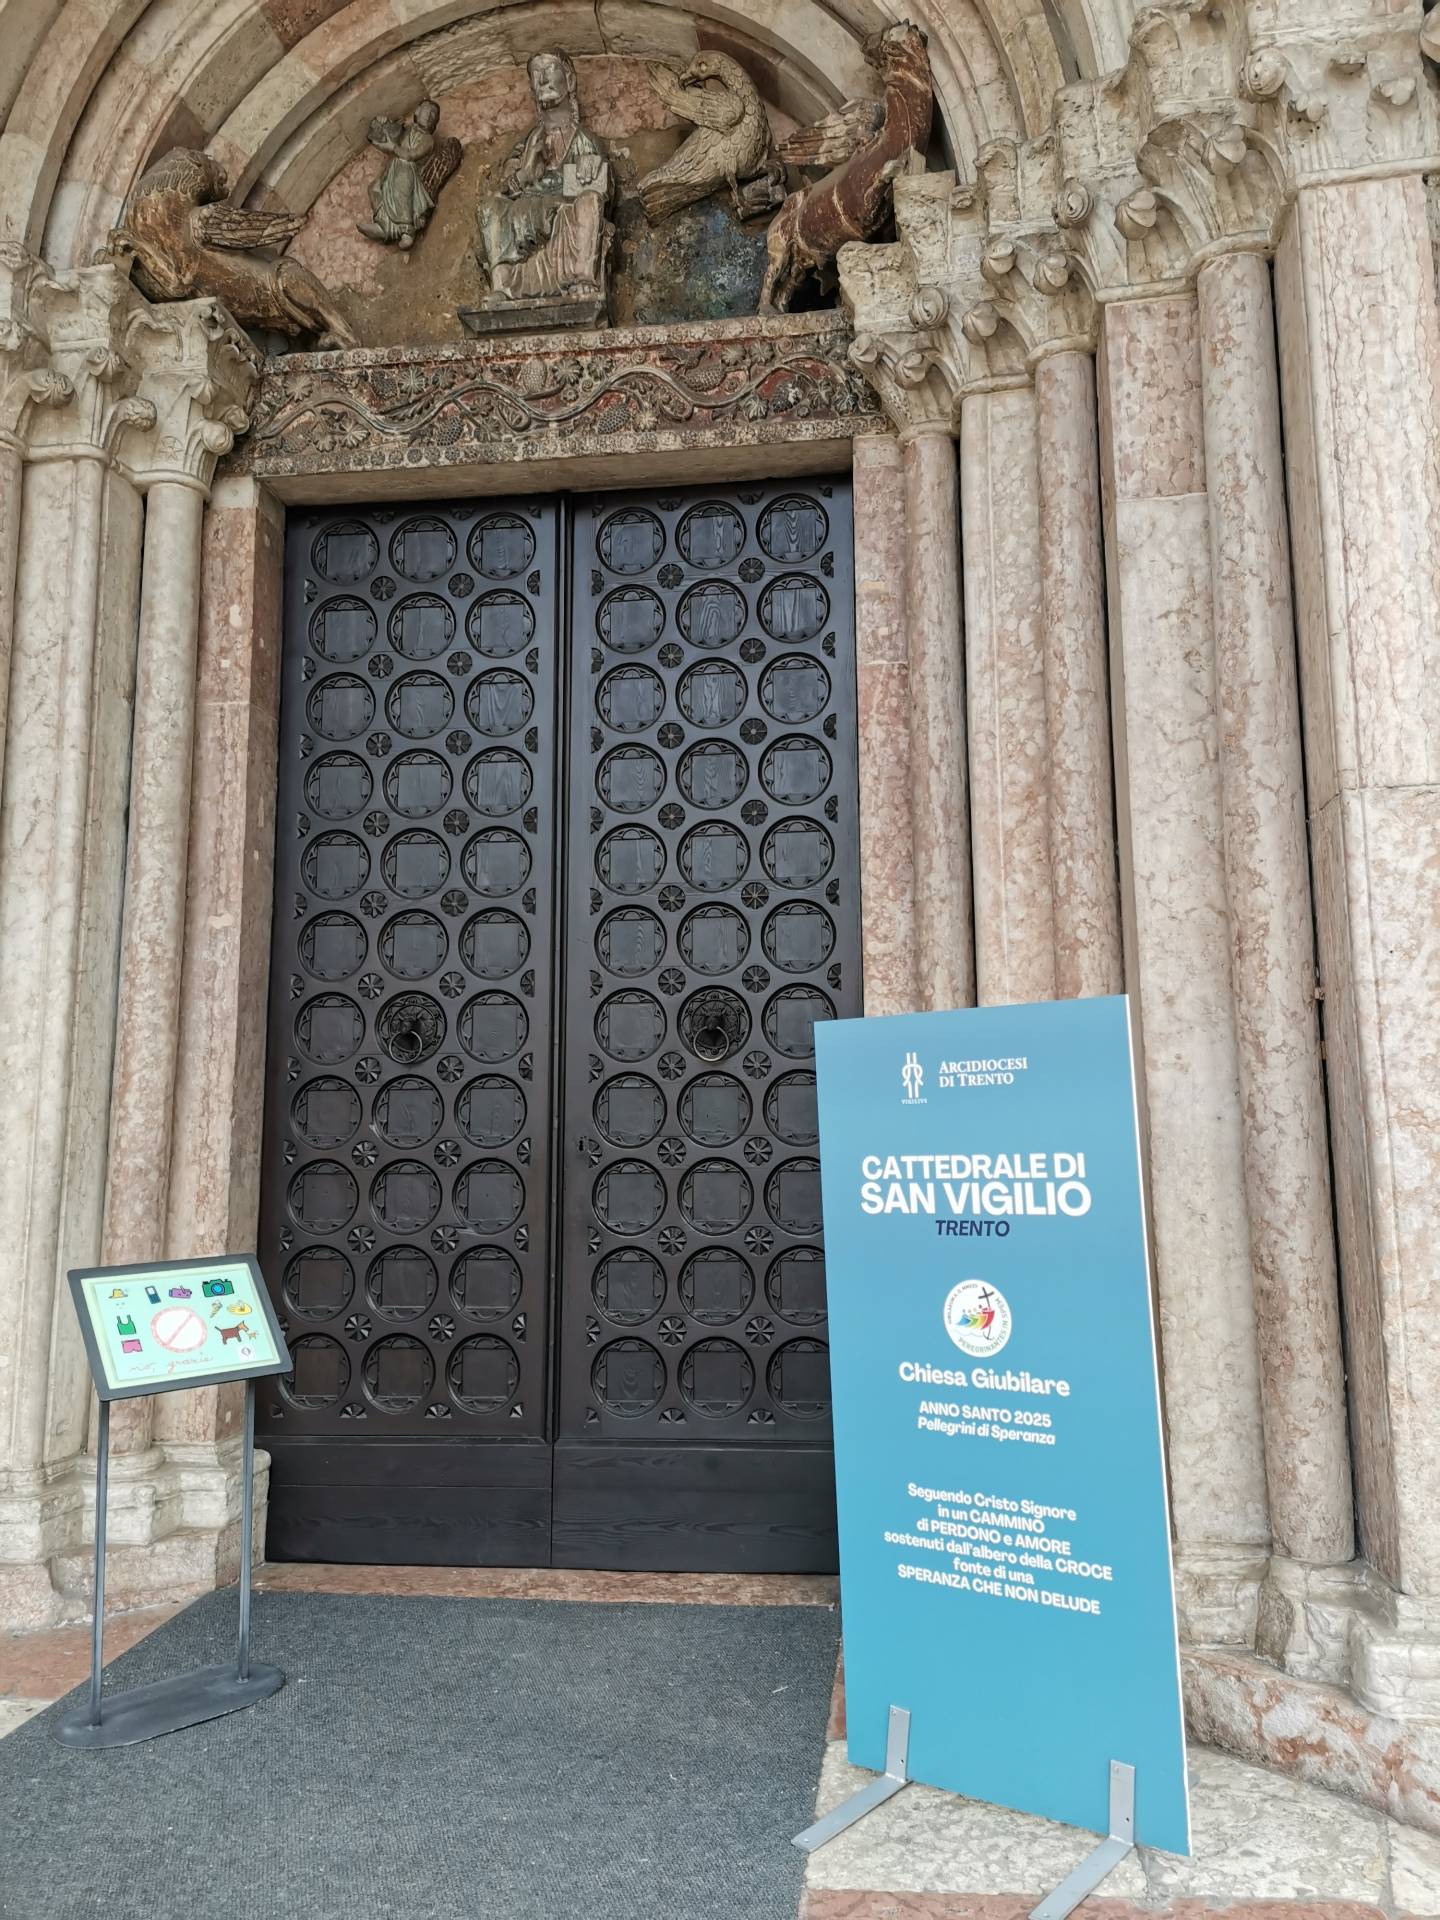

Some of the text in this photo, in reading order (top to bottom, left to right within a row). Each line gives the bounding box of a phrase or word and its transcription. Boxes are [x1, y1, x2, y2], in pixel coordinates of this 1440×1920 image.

[939, 1057, 1028, 1074] ARCIDIOCESI
[939, 1072, 1014, 1088] DI TRENTO
[862, 1152, 1086, 1180] CATTEDRALE DI
[860, 1181, 1092, 1217] SAN VIGILIO
[935, 1220, 1010, 1238] TRENTO
[899, 1361, 1071, 1397] Chiesa Giubilare
[919, 1400, 1052, 1428] ANNO SANTO 2025
[918, 1416, 1056, 1445] Pellegrini di Speranza
[908, 1482, 1077, 1521] Seguendo Cristo Signore
[937, 1504, 1045, 1534] in un CAMMINO
[916, 1518, 1071, 1556] di PERDONO e AMORE
[884, 1531, 1113, 1581] sostenuti dall'albero della CROCE
[953, 1557, 1035, 1585] fonte di una
[897, 1563, 1101, 1615] SPERANZA CHE NON DELUDE
